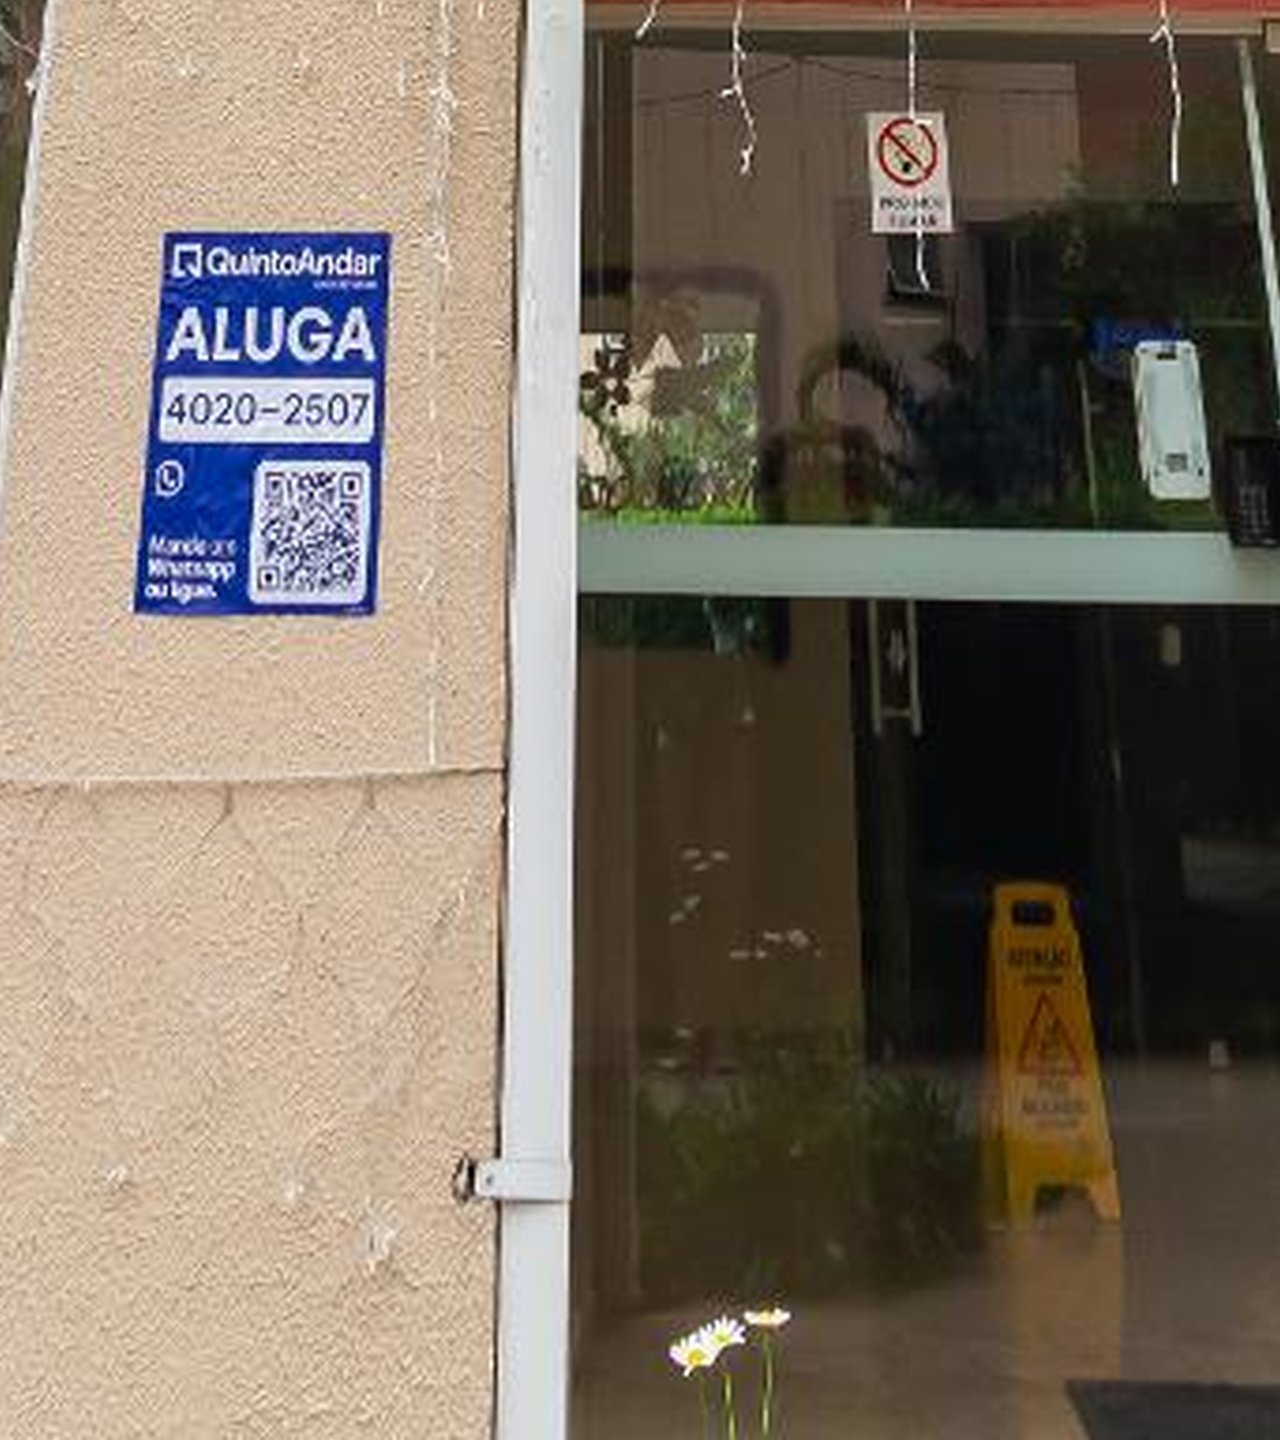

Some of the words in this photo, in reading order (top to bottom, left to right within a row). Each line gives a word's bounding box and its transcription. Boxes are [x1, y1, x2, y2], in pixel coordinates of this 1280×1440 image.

[207, 246, 381, 276] QuintoAndar
[166, 306, 376, 362] ALUGA
[167, 392, 370, 426] 4020-2507
